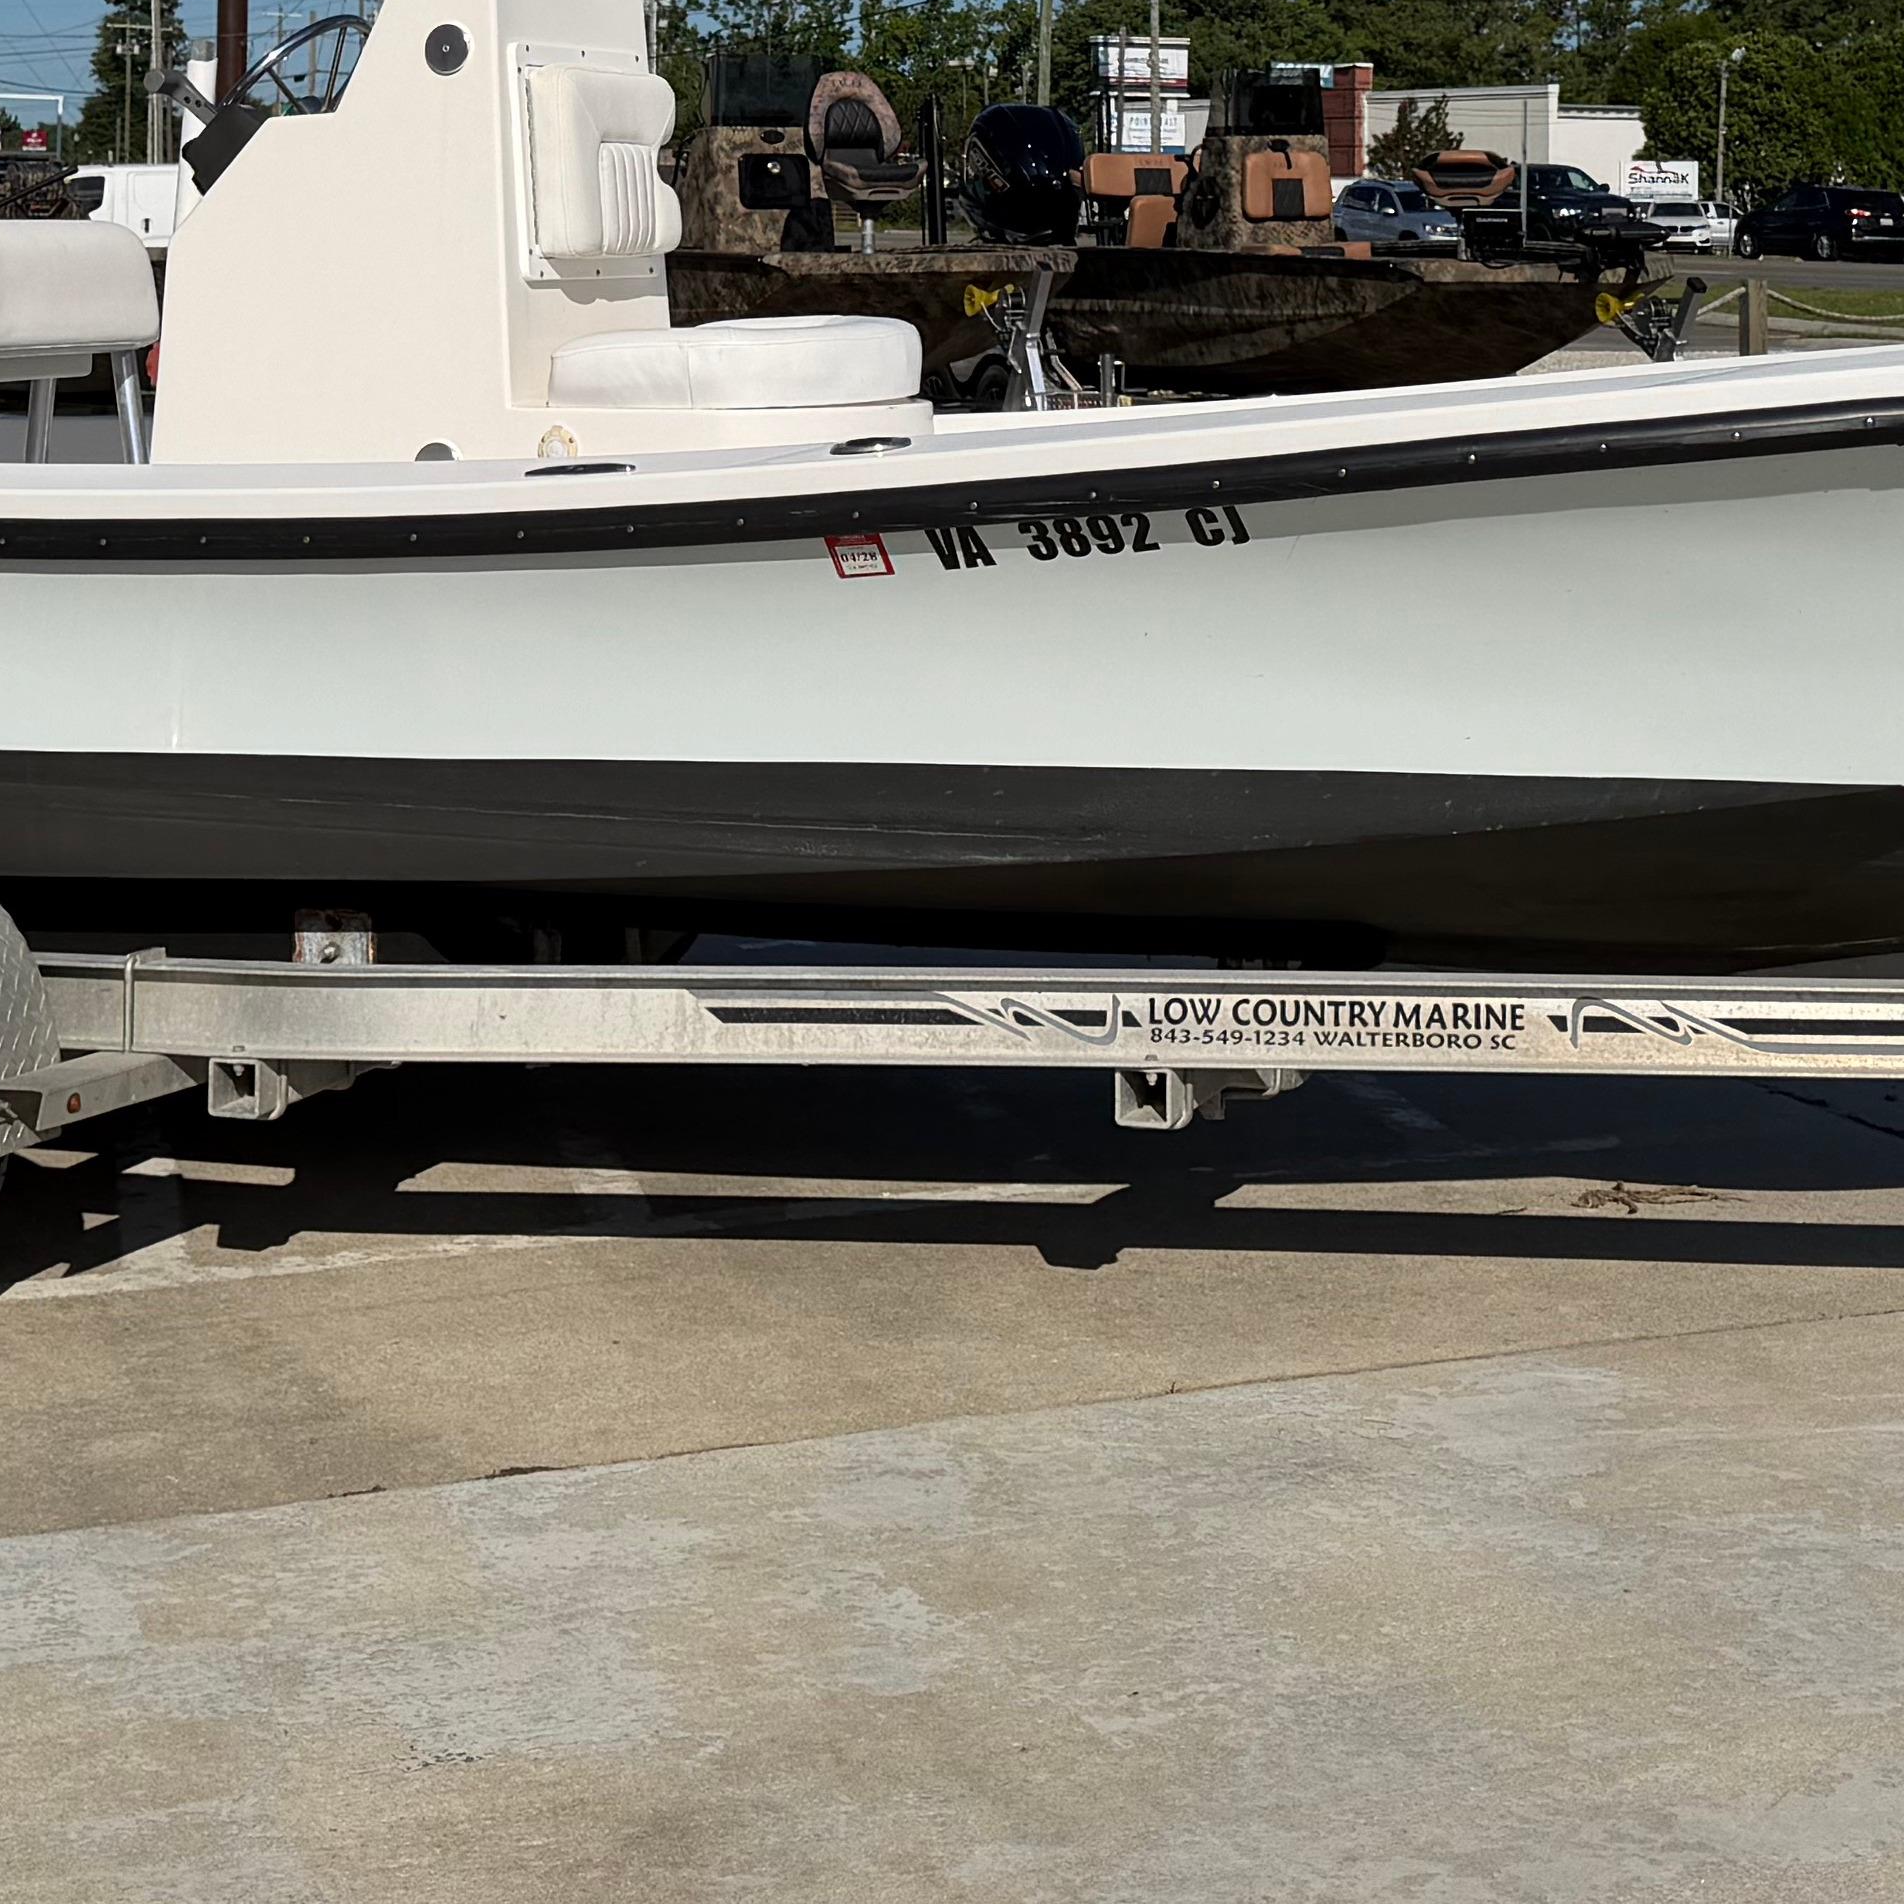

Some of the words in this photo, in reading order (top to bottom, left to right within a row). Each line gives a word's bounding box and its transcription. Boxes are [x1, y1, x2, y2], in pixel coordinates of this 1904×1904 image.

[924, 527, 997, 571] VA
[1018, 512, 1160, 562] 3892
[1185, 505, 1251, 547] CJ
[1148, 998, 1221, 1025] LOW
[1232, 998, 1386, 1028] COUNTRY
[1393, 1003, 1525, 1031] MARINE
[1150, 1028, 1306, 1047] 843-549-1234
[1313, 1031, 1482, 1050] WALTERBORO
[1490, 1035, 1517, 1051] SC
